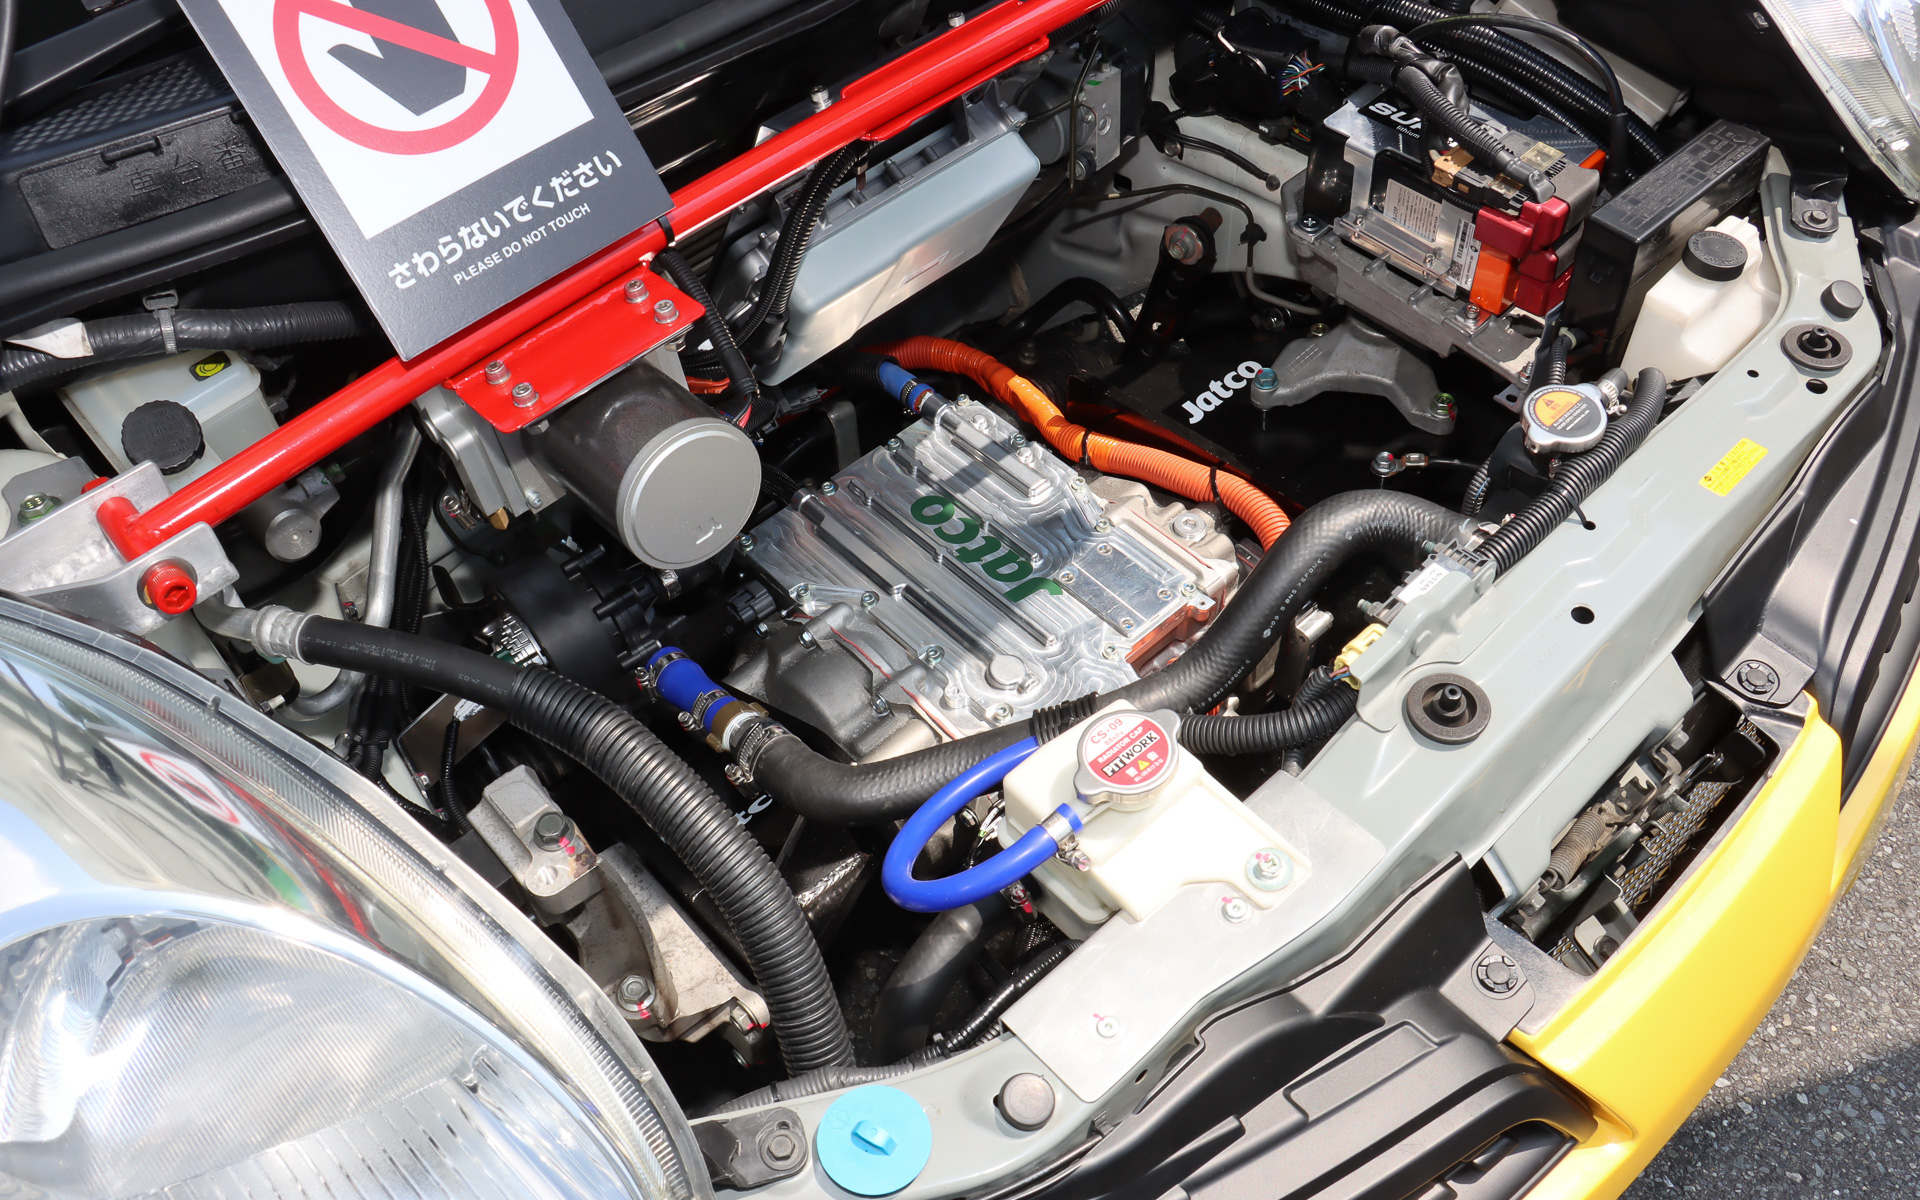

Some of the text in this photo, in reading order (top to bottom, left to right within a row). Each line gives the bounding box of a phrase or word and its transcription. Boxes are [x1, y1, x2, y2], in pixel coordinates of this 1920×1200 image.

[1396, 125, 1420, 139] lithium
[387, 149, 623, 289] さわらないでください
[453, 202, 591, 285] PLEASE DO NOT TOUCH
[1181, 360, 1263, 424] Jatco
[910, 495, 1064, 604] Jatco
[1090, 718, 1123, 744] CS-09
[1097, 726, 1144, 763] RADIATOR CAP
